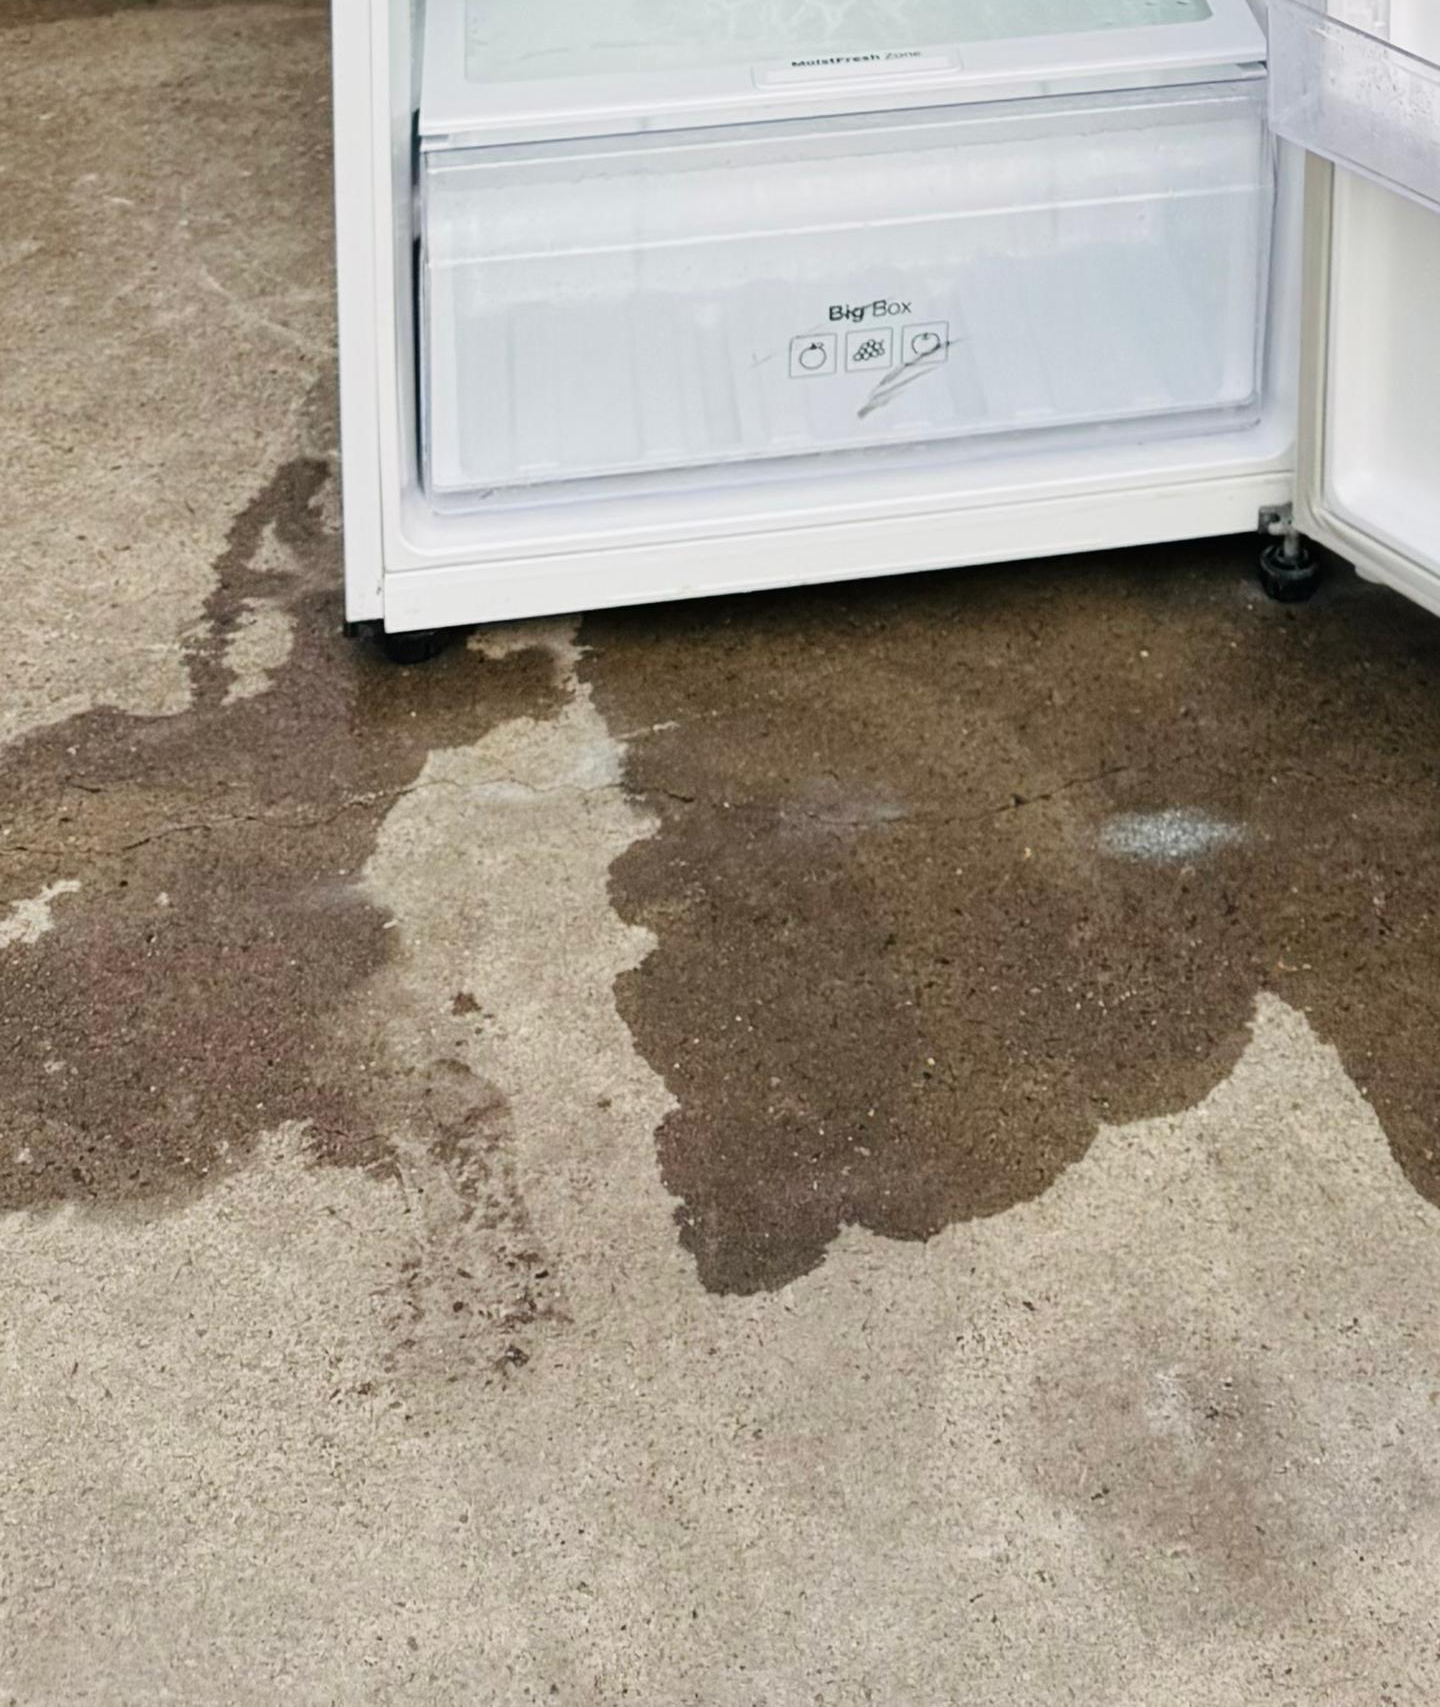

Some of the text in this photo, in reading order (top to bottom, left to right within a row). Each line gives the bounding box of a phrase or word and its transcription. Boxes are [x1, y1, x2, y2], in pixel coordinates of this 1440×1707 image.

[885, 51, 921, 60] Zone
[829, 299, 912, 323] Big Box
